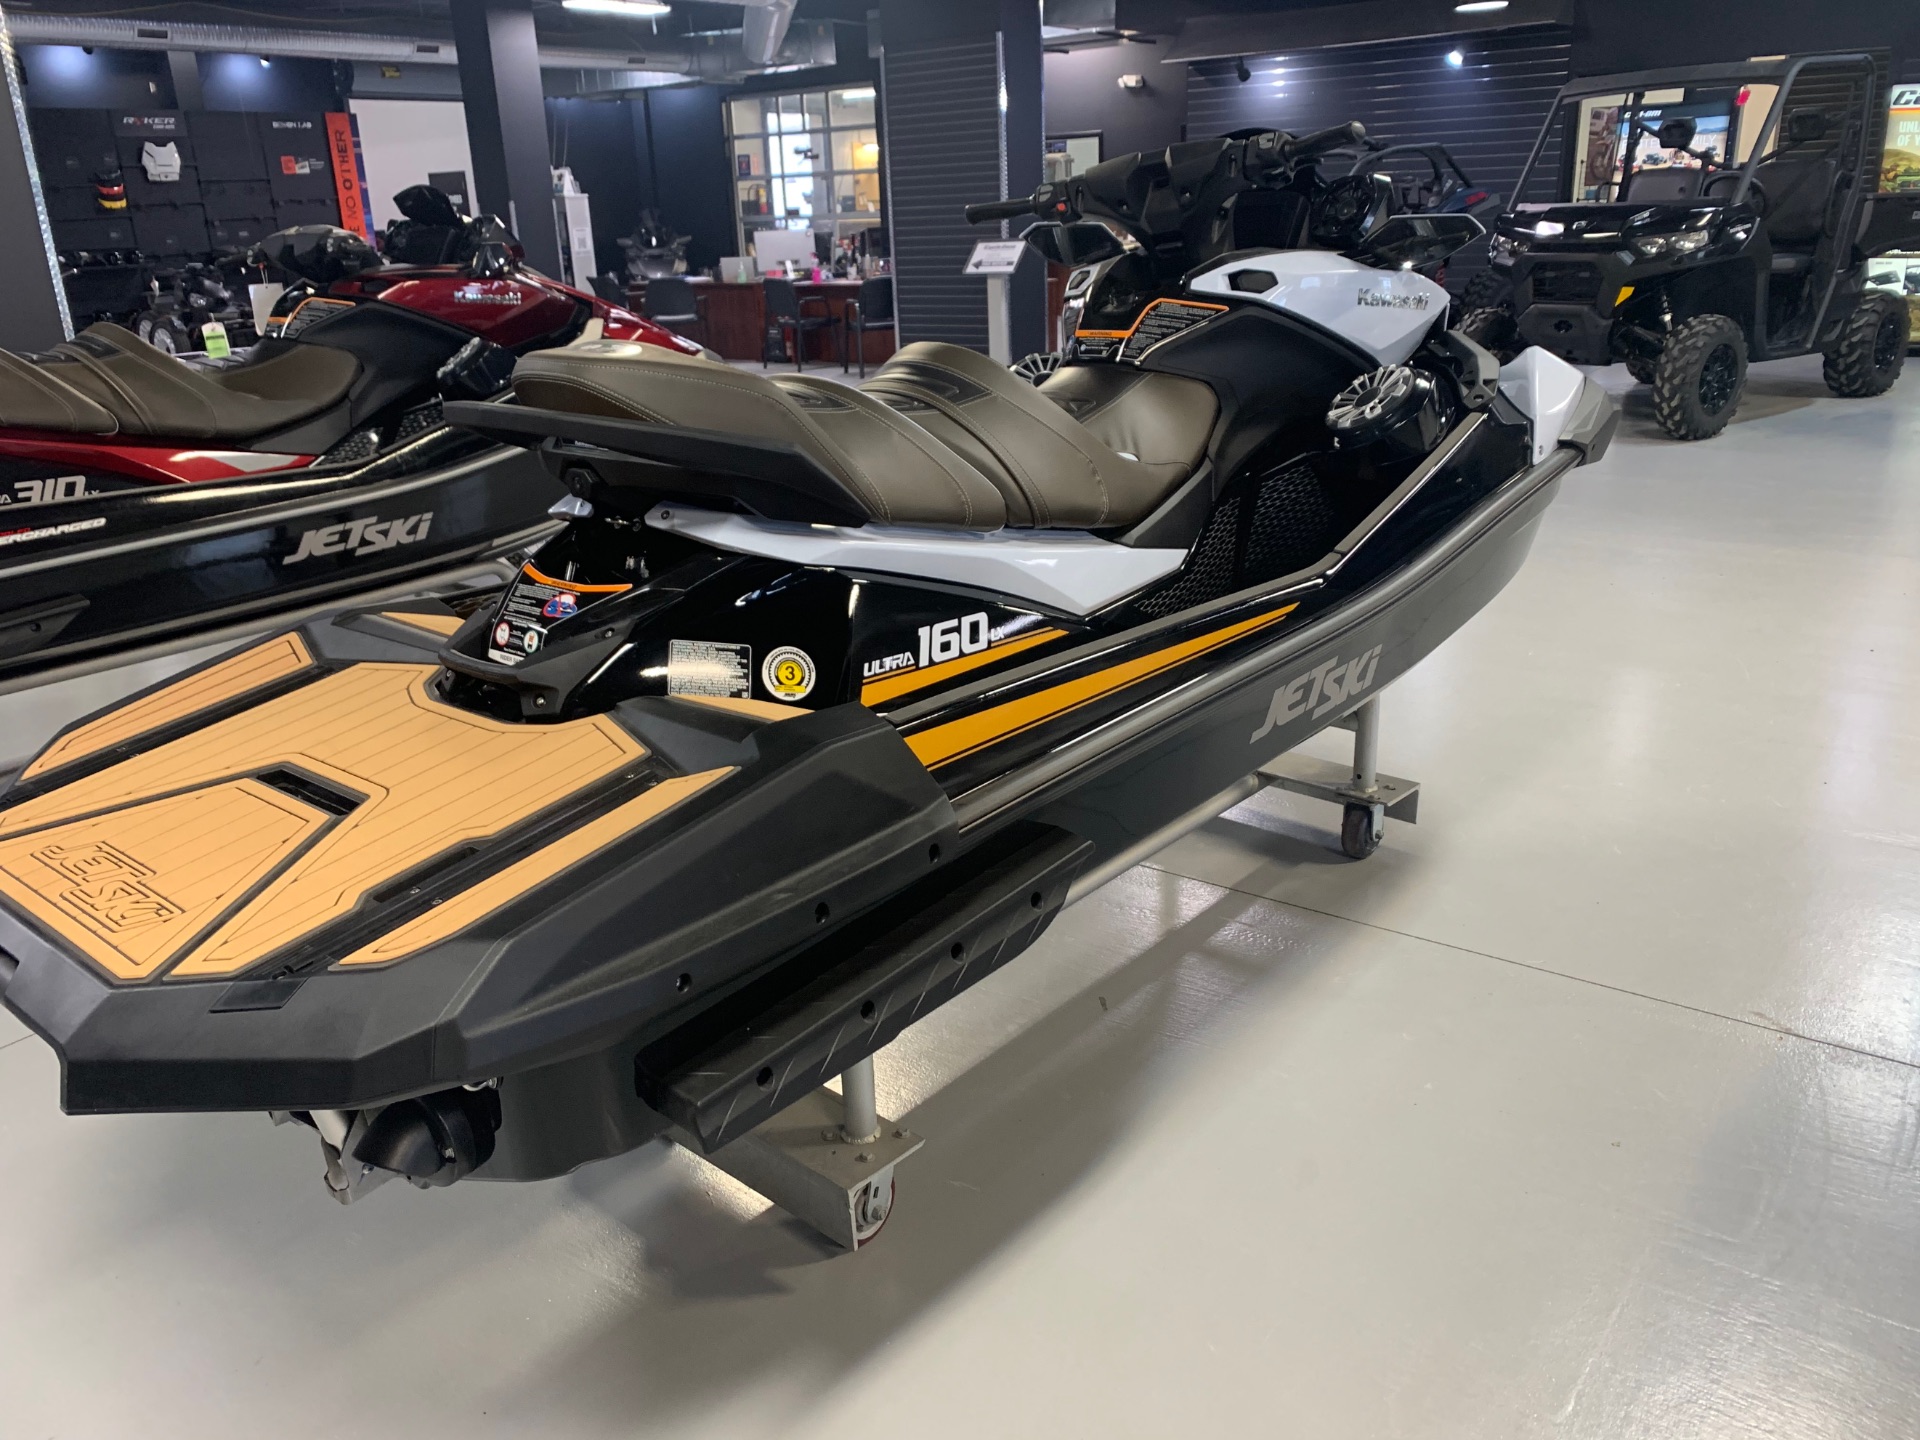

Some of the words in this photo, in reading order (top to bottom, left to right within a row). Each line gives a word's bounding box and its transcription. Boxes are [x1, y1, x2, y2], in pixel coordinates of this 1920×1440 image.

[1897, 134, 1911, 147] OF
[334, 129, 354, 191] OTHER
[453, 291, 521, 305] Kawasaki
[1357, 288, 1429, 310] Kawasaki
[14, 475, 86, 504] 310
[863, 651, 915, 677] ULTRA
[918, 611, 989, 668] 160
[990, 625, 1005, 641] LX
[785, 665, 796, 681] 3
